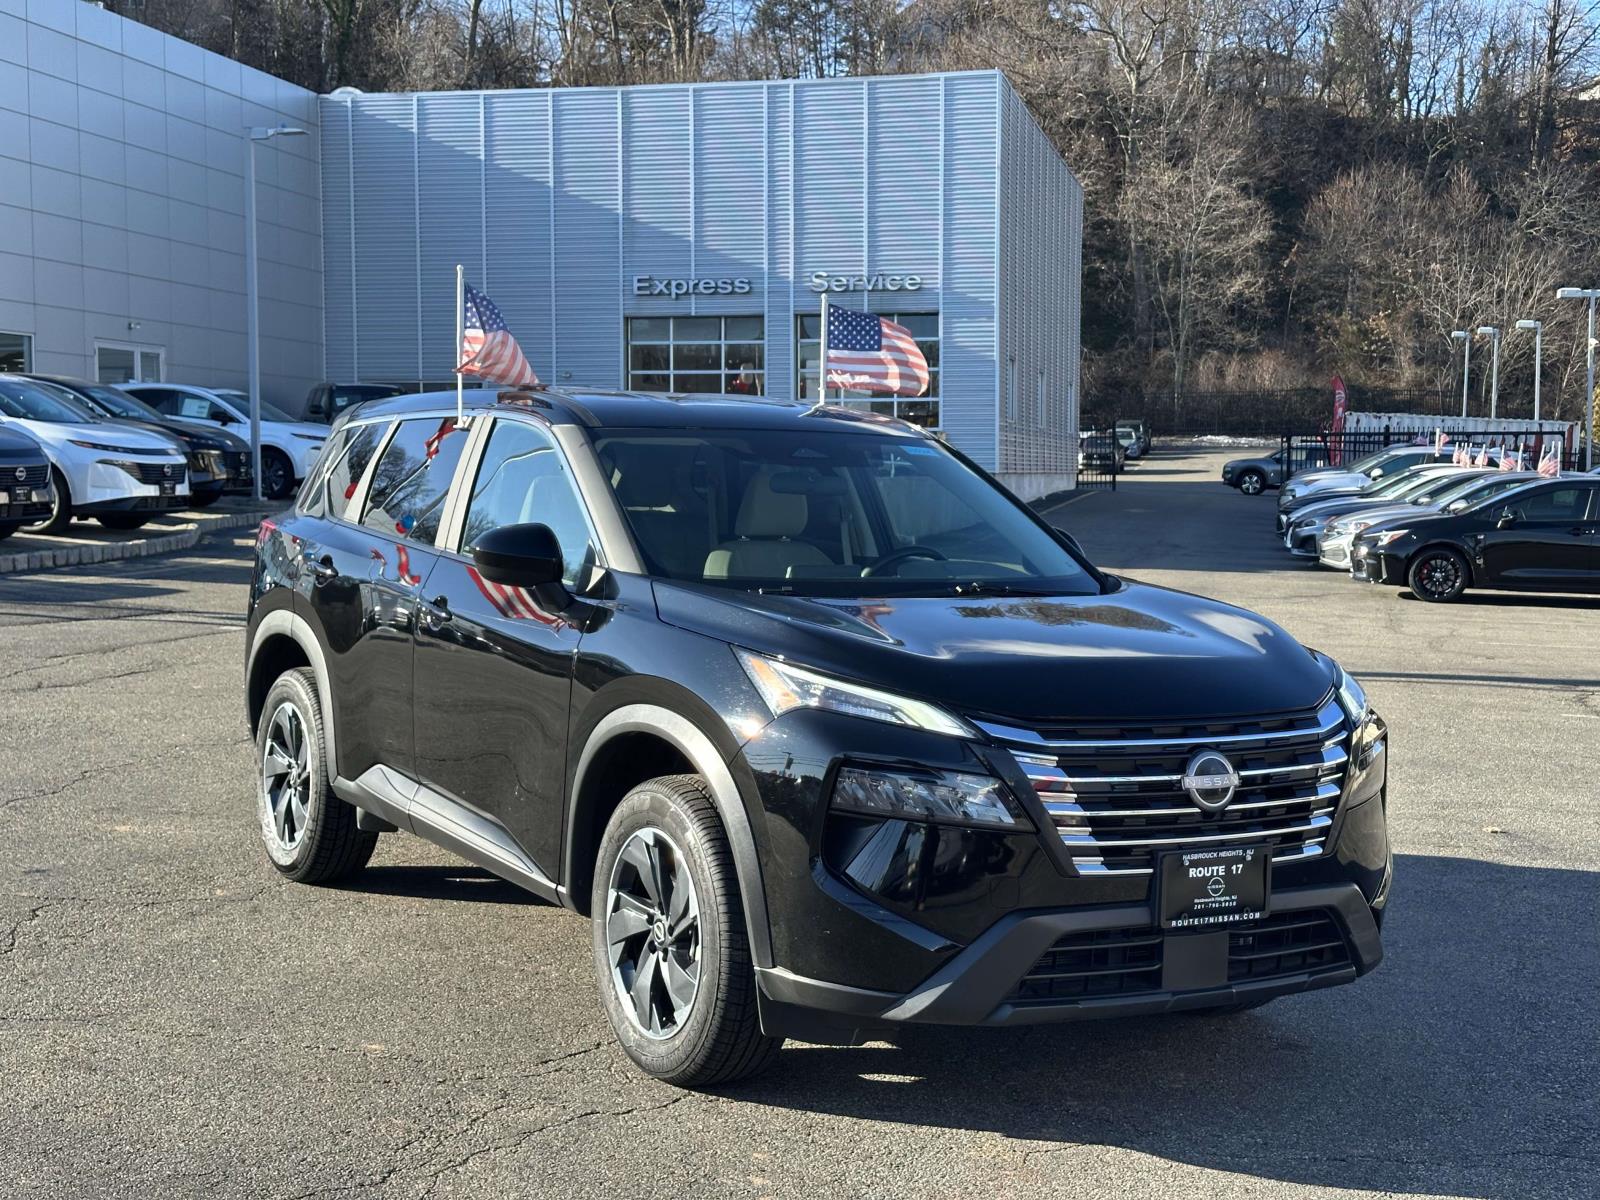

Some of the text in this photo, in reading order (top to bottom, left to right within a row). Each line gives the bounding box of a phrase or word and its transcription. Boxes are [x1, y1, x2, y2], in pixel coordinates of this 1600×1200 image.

[632, 271, 922, 300] Express Service
[1187, 775, 1238, 786] NISSAN
[1189, 864, 1244, 878] ROUTE 17
[1171, 912, 1260, 927] ROUTE17NISSAN.COM
